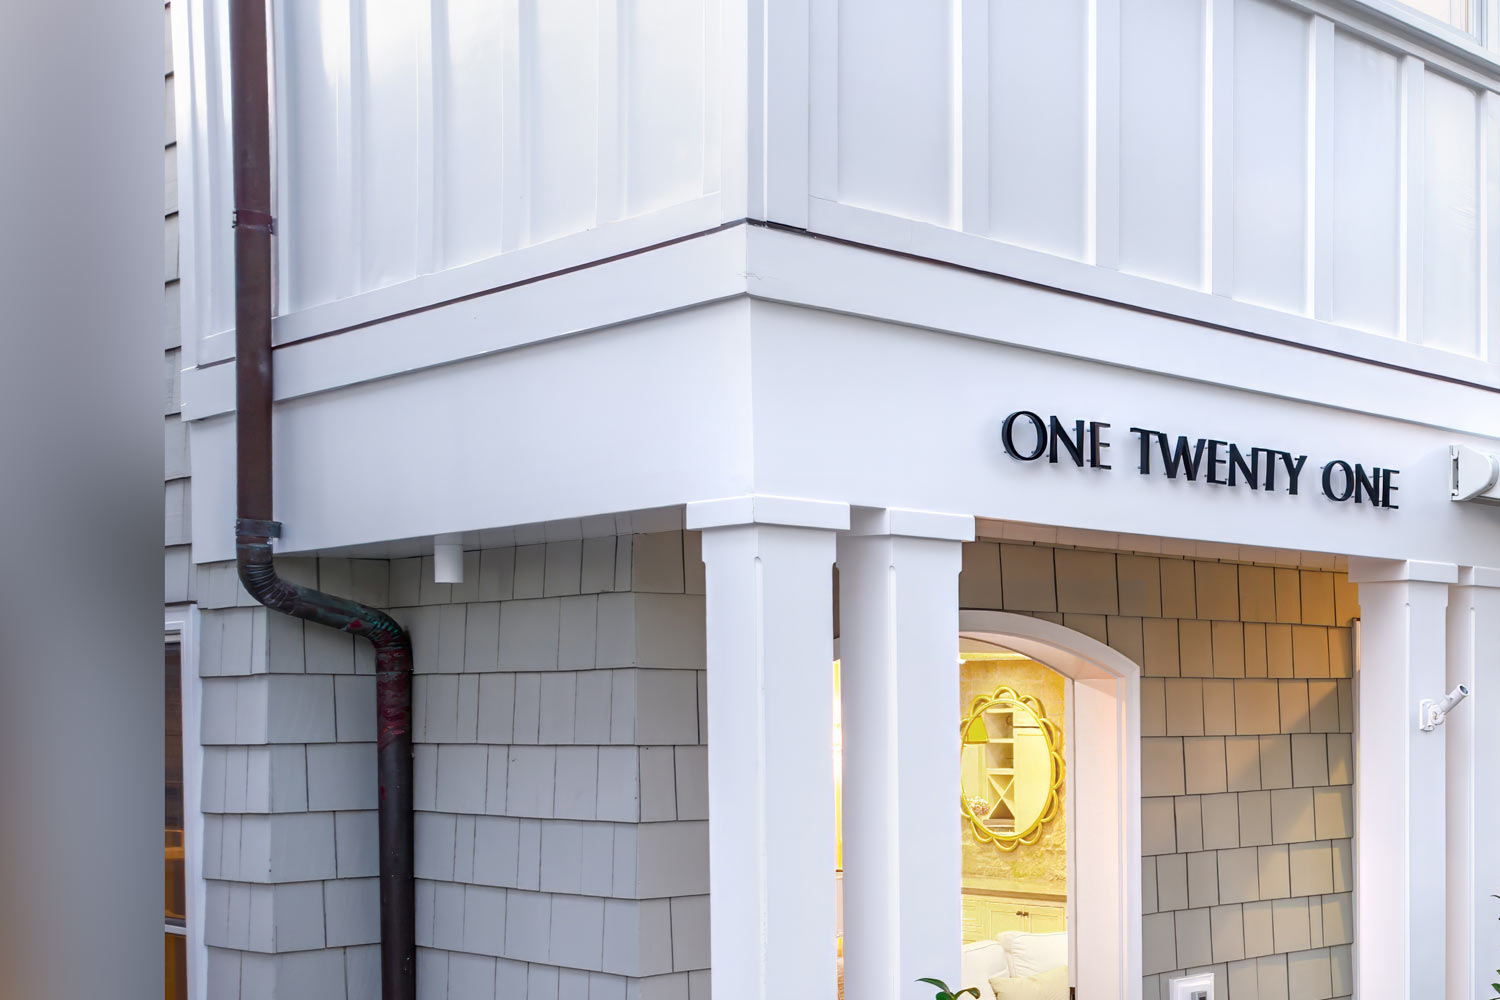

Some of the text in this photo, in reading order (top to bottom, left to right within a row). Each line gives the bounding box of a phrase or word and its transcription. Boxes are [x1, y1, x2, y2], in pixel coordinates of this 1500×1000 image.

[1002, 411, 1399, 509] ONE TWENTY ONE
